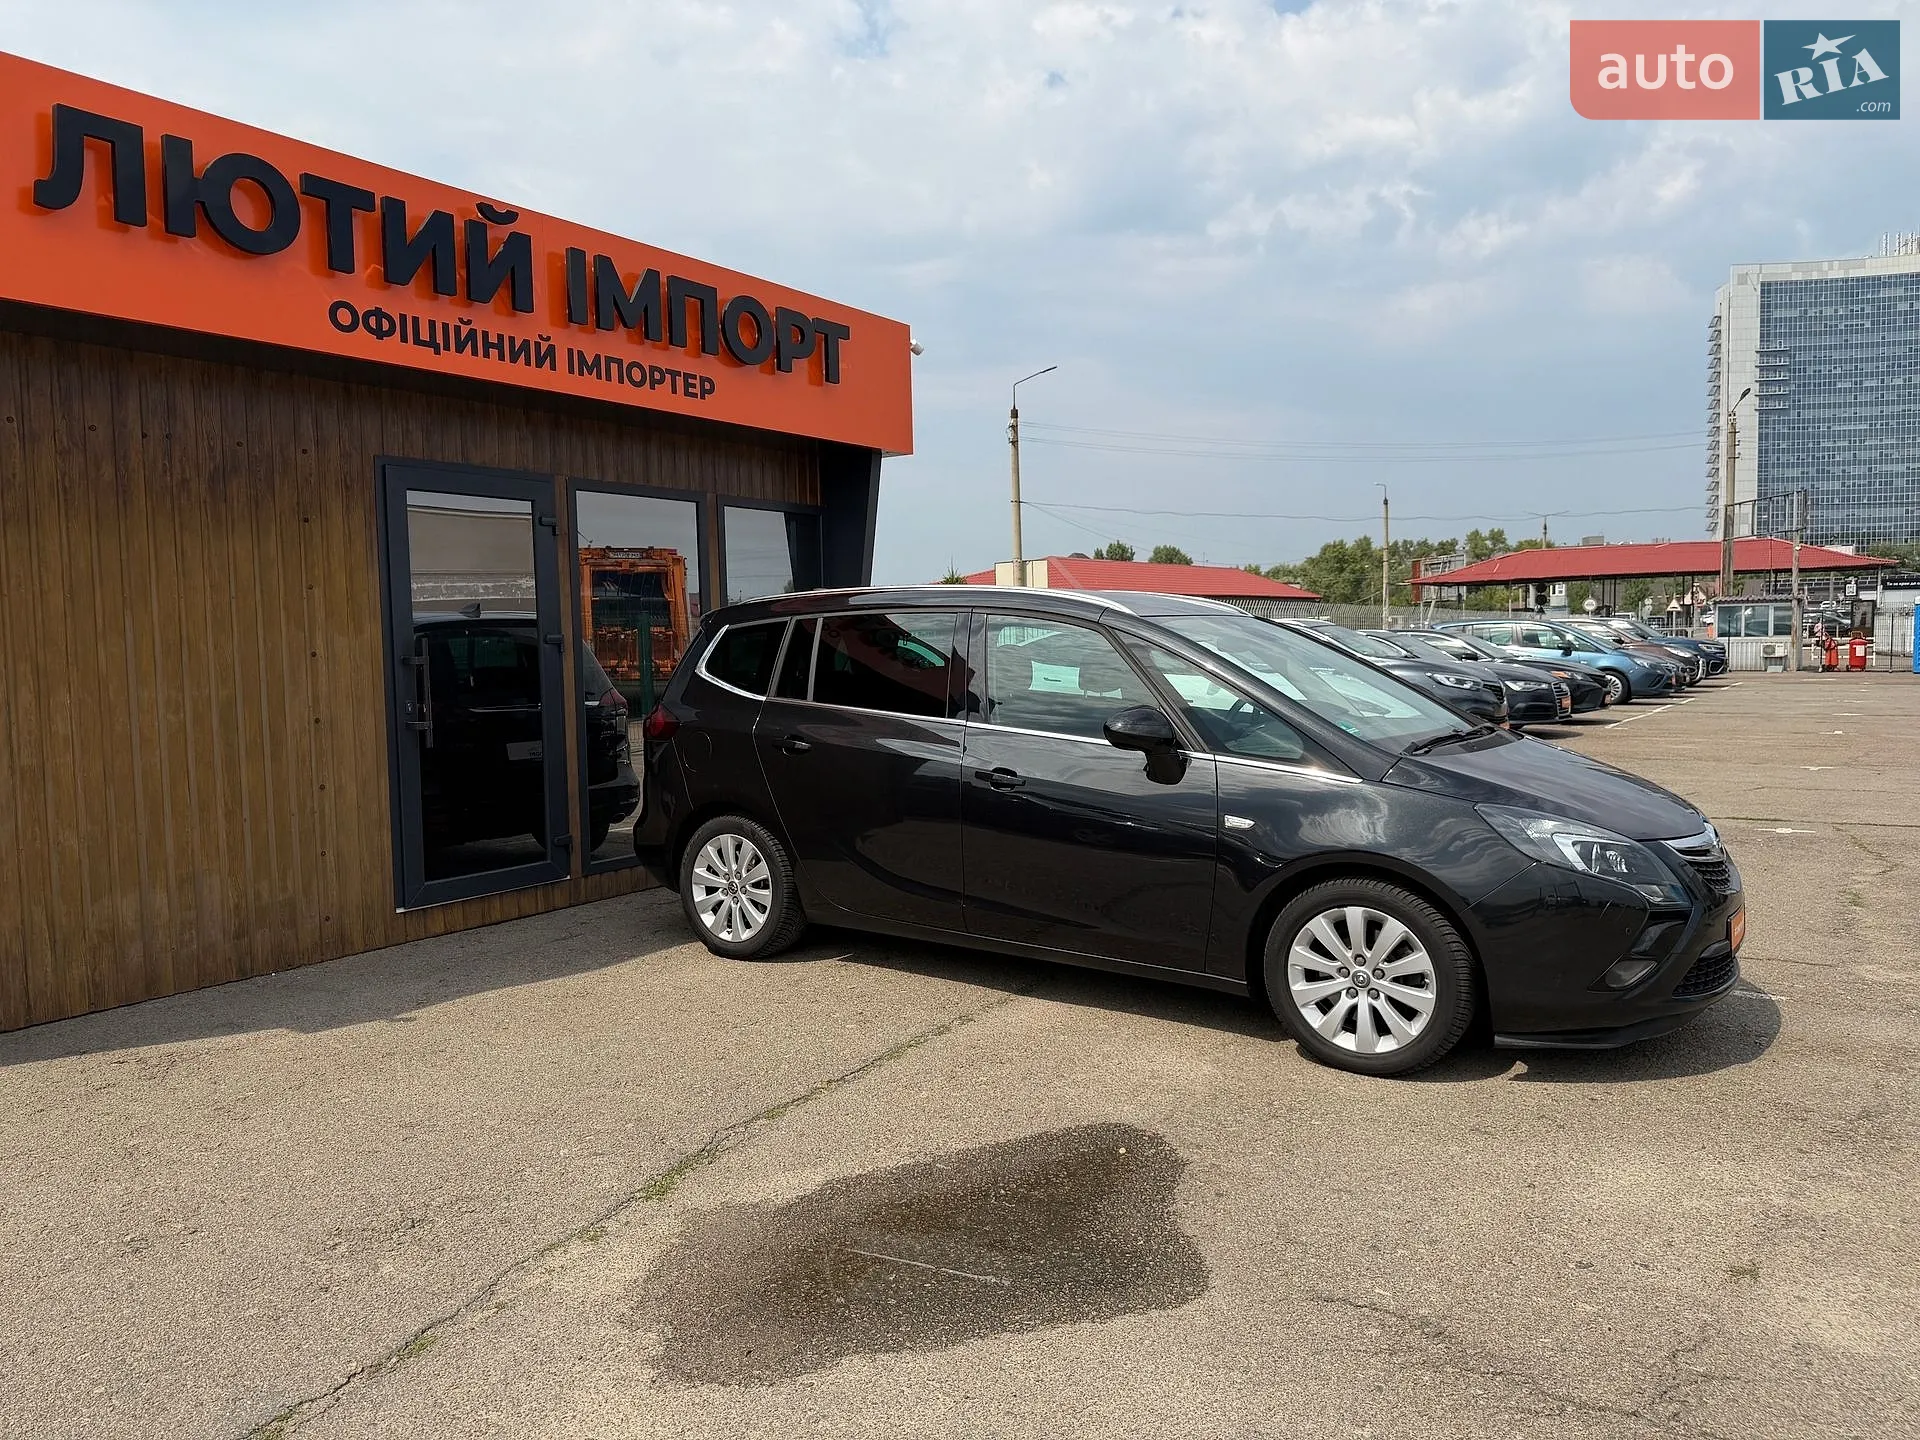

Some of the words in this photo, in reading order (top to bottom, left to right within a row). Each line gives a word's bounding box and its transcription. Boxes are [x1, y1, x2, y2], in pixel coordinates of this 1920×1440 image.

[34, 103, 534, 314] ЛЮТИЙ
[565, 246, 850, 385] ІМПОРТ
[328, 300, 557, 372] ОФІЦІЙНИЙ
[567, 347, 716, 400] ІМПОРТЕР
